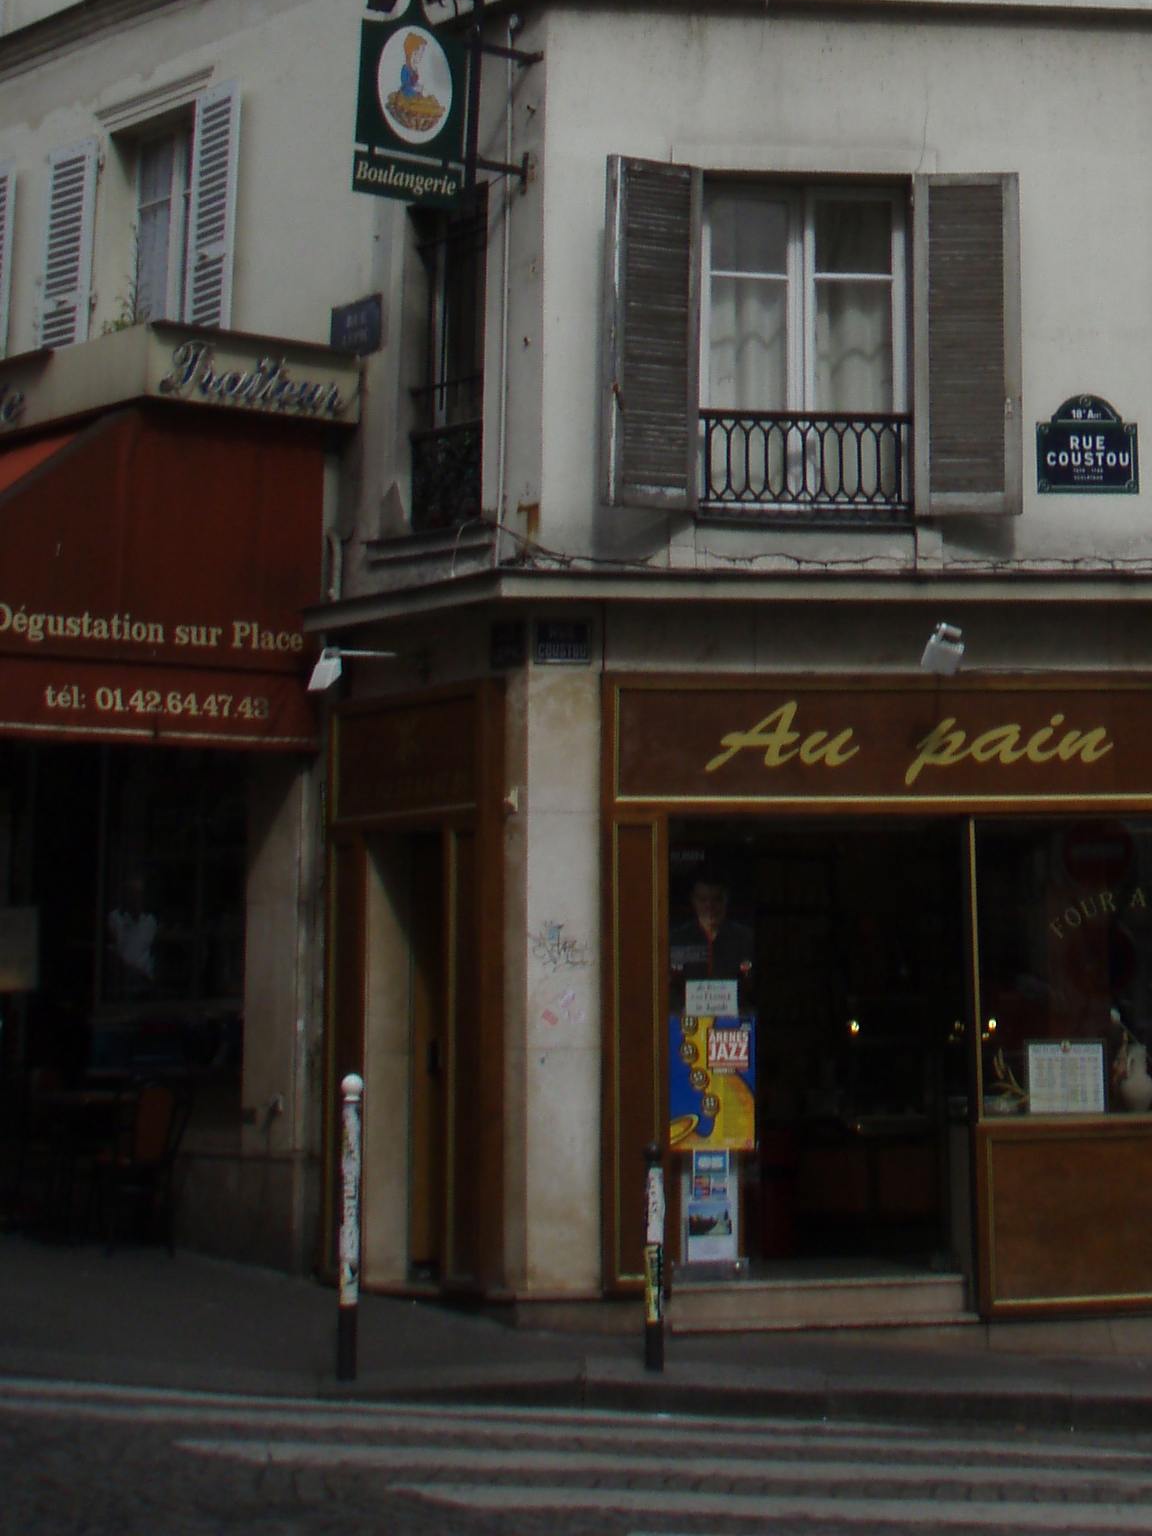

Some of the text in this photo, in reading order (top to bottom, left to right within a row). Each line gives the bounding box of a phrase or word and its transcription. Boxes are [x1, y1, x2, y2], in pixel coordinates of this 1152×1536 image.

[357, 161, 457, 196] Boulangerie
[158, 340, 347, 414] Traiteur
[1046, 451, 1129, 467] COUSTOU
[1070, 435, 1105, 451] RUE
[0, 603, 304, 653] Dégustation sur Place
[45, 684, 269, 720] tél: 01.42.64.47.43
[704, 699, 862, 774] Au
[904, 712, 1115, 786] pain
[1049, 892, 1117, 940] FOUR
[709, 1043, 749, 1061] JAZZ
